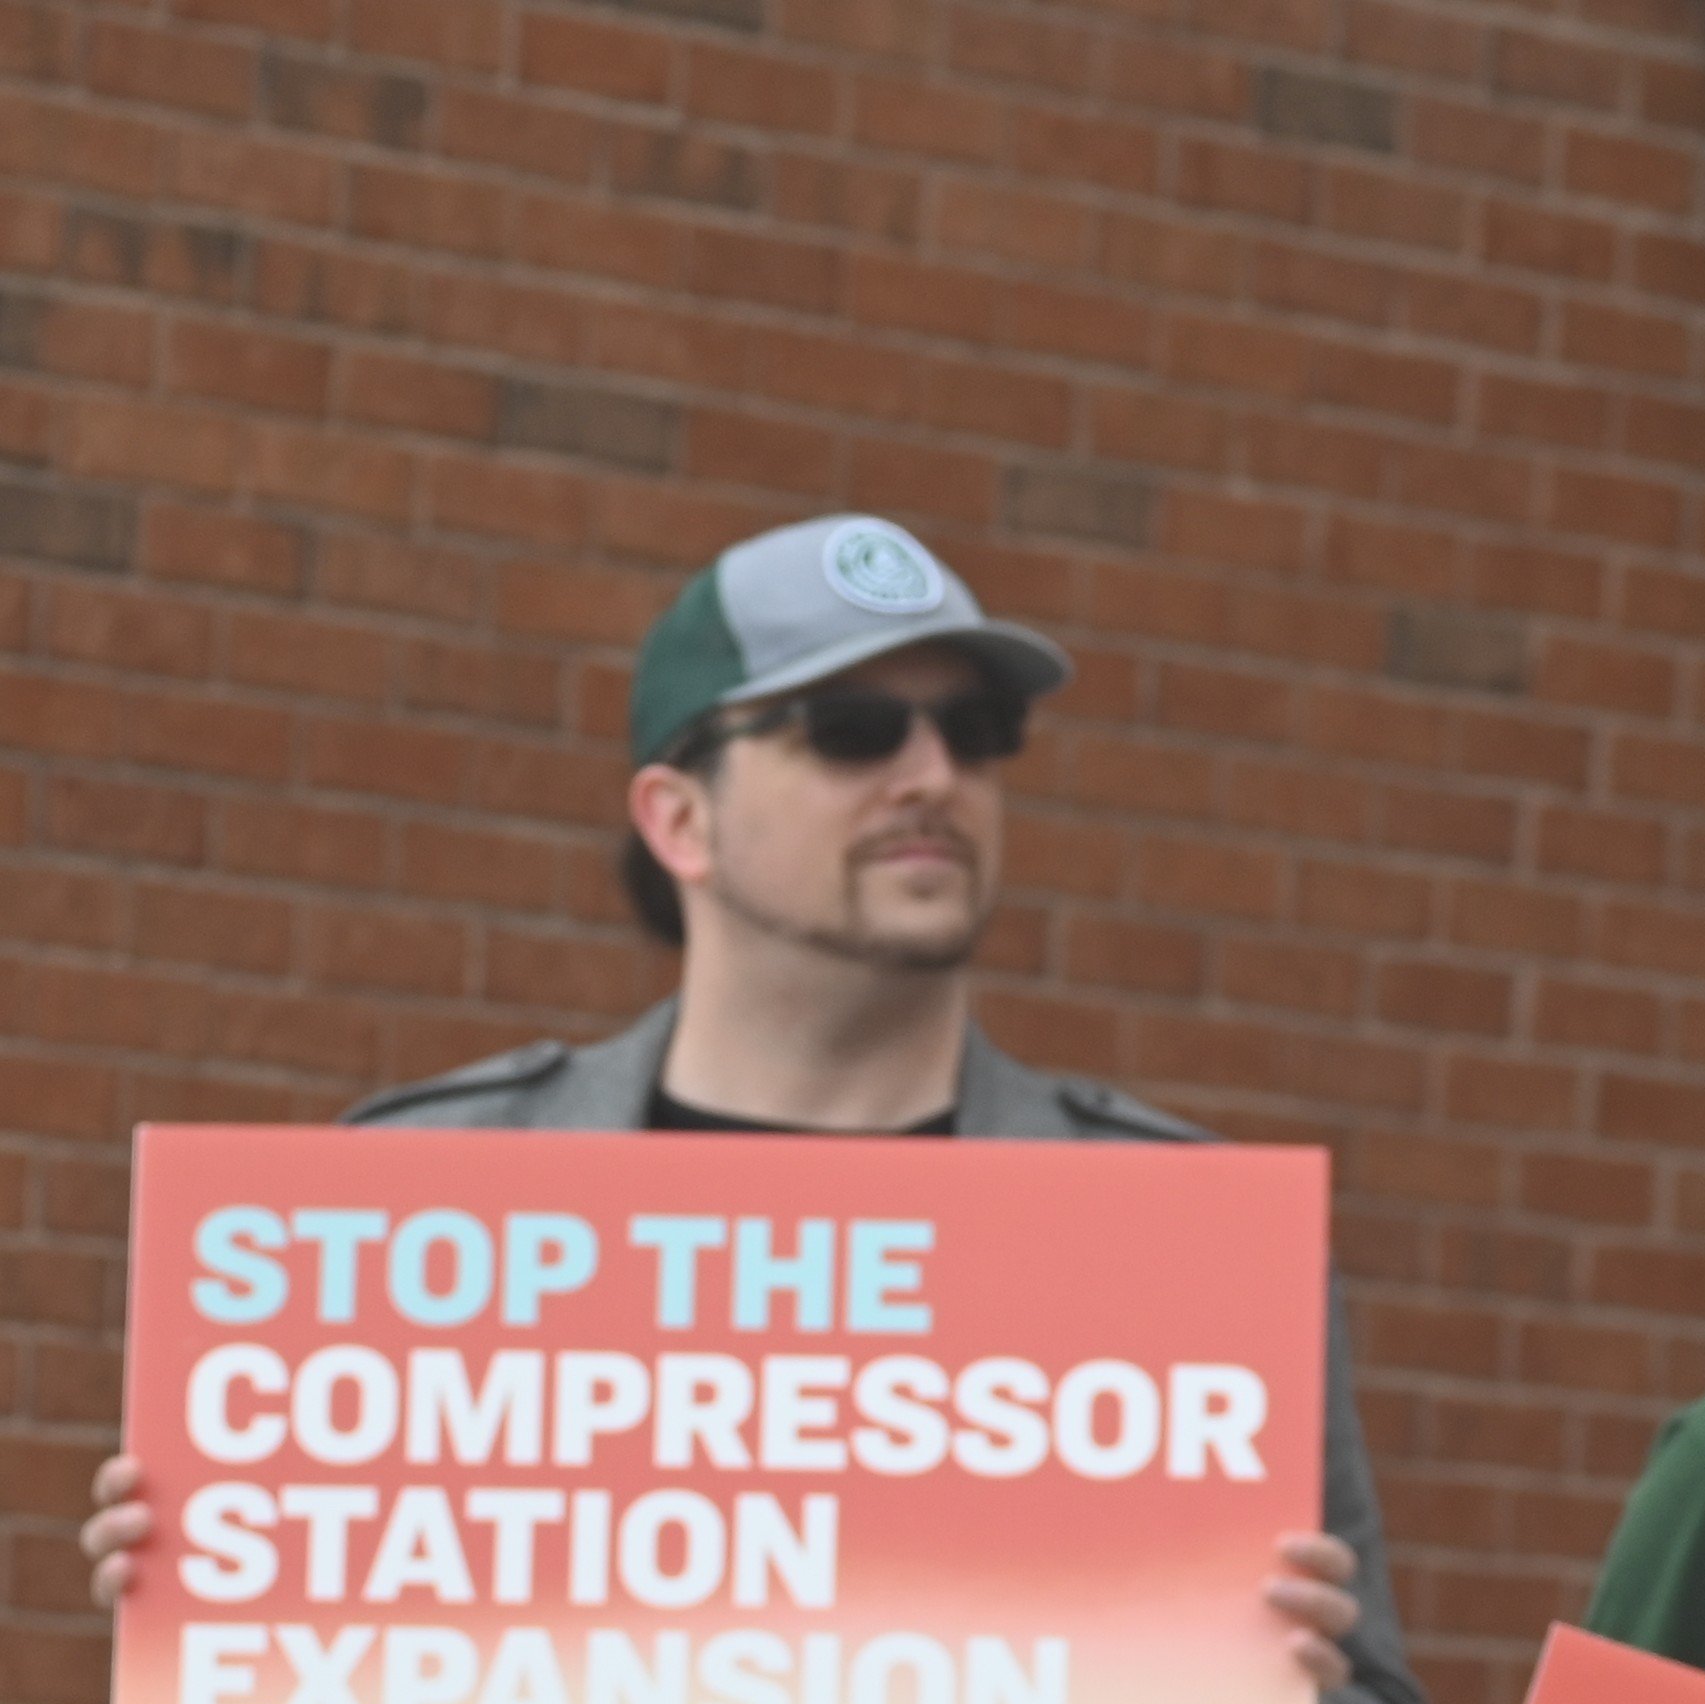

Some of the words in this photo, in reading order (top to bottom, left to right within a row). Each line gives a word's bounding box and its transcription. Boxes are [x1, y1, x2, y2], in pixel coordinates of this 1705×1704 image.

[189, 1203, 599, 1328] STOP
[629, 1214, 935, 1334] THE
[185, 1344, 1268, 1482] COMPRESSOR
[177, 1482, 840, 1609] STATION
